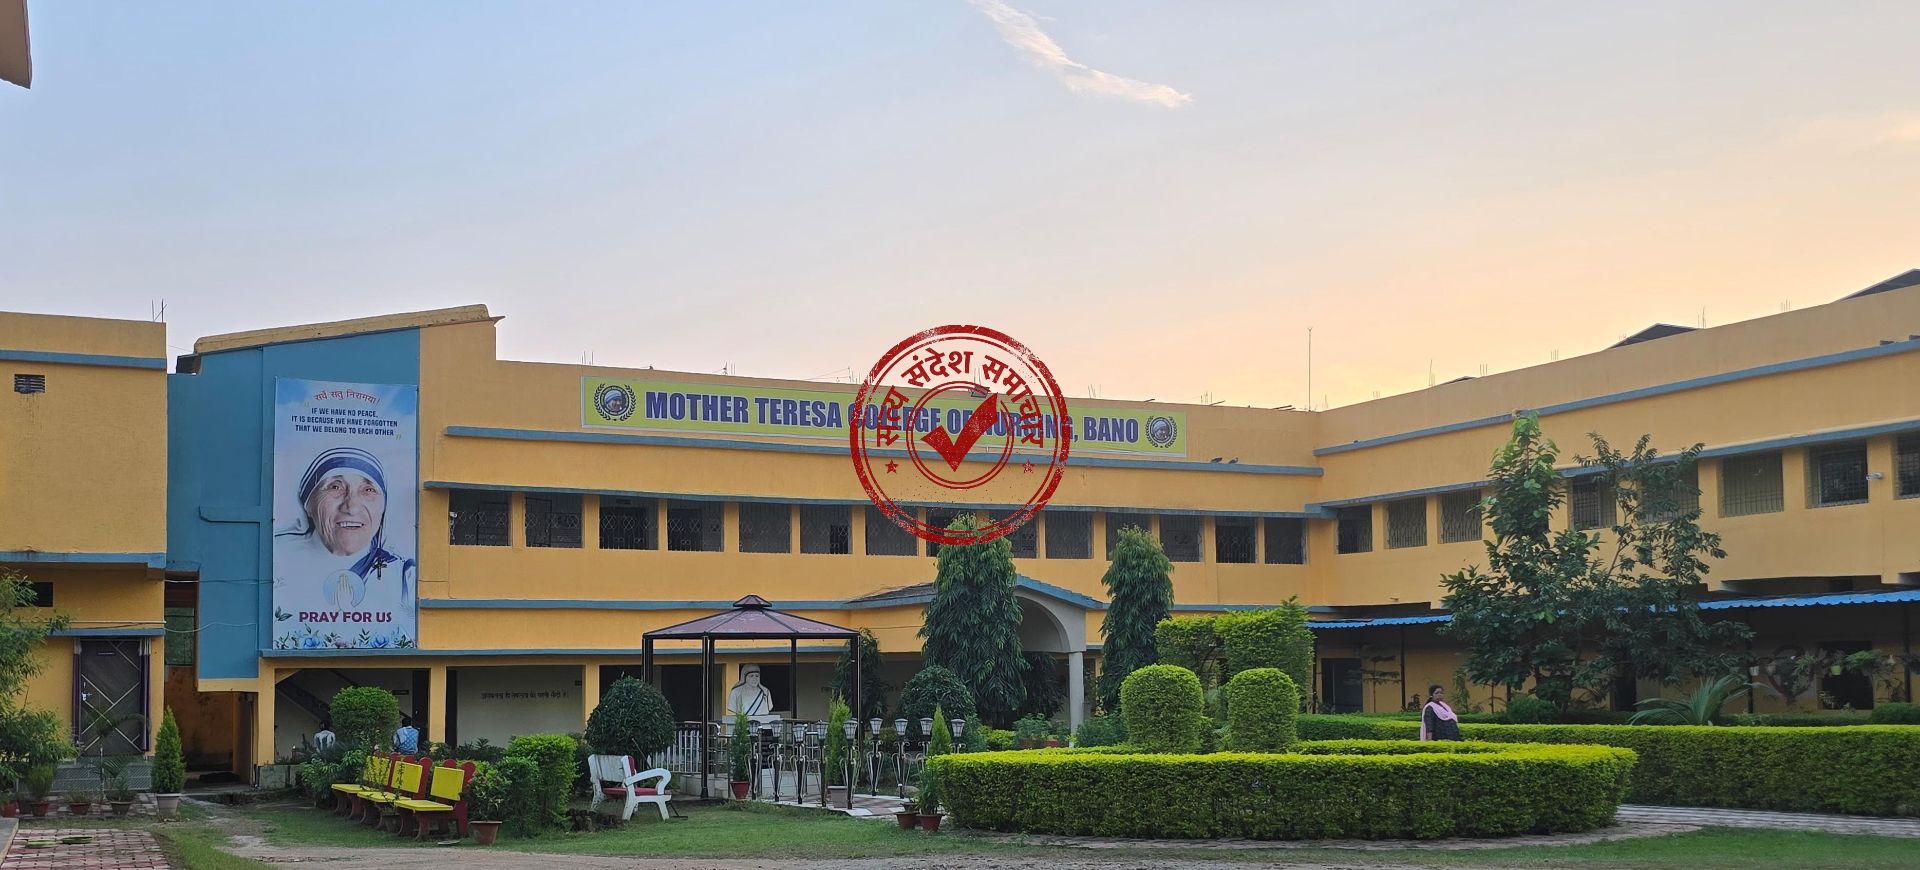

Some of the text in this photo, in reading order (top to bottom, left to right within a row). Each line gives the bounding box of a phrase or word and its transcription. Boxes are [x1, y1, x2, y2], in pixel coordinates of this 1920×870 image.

[311, 407, 318, 415] IF
[319, 407, 329, 415] WE
[331, 408, 346, 416] HAVE
[347, 409, 356, 417] NO
[645, 391, 749, 424] MOTHER
[755, 397, 842, 428] TERESA
[848, 403, 941, 433] COLLEGE
[947, 409, 974, 434] OF
[982, 412, 1079, 442] URSIN,
[1083, 416, 1138, 443] BANO
[299, 415, 306, 423] IS
[307, 416, 334, 424] BECAUSE
[335, 417, 346, 425] WE
[346, 418, 363, 426] HAVE
[363, 419, 398, 427] FORGOTTEN
[295, 424, 311, 432] THAT
[312, 425, 323, 433] WE
[324, 426, 347, 434] BELONG
[358, 427, 374, 435] EACH
[374, 428, 394, 436] OTHER
[299, 611, 392, 623] PRAY FOR US
